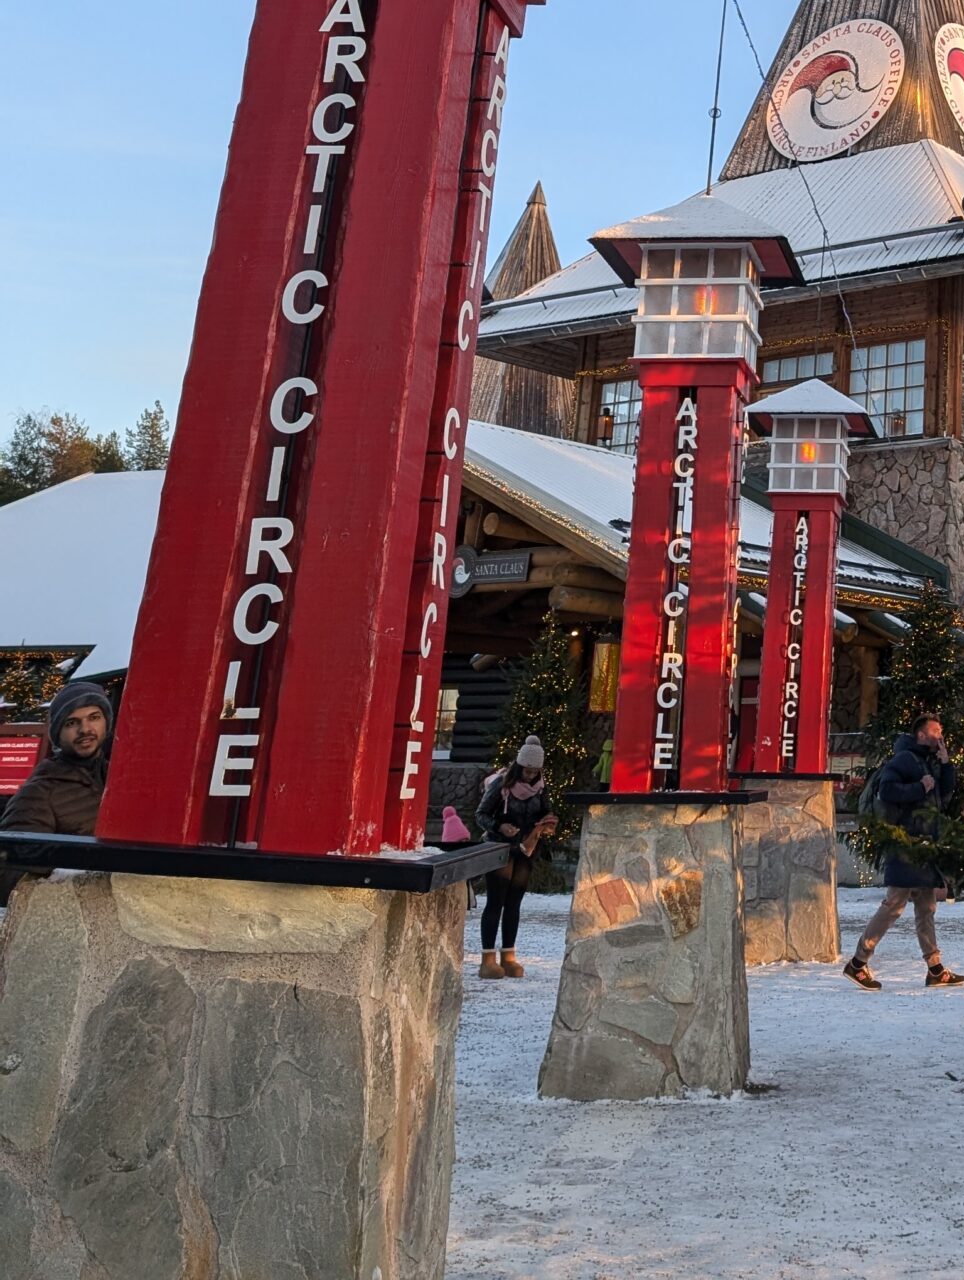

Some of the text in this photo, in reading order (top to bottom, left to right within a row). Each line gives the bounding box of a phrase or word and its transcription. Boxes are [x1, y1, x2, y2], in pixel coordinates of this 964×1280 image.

[802, 22, 901, 108] SANTA CLAUS OFFICE
[805, 120, 871, 158] FINLAND
[937, 41, 952, 95] ARCTIC
[400, 24, 510, 800] ARCTIC CIRCLE
[208, 377, 319, 797] CIRCLE
[653, 396, 698, 770] ARCTIC CIRCLE
[781, 517, 808, 757] ARCTIC CIRCLE
